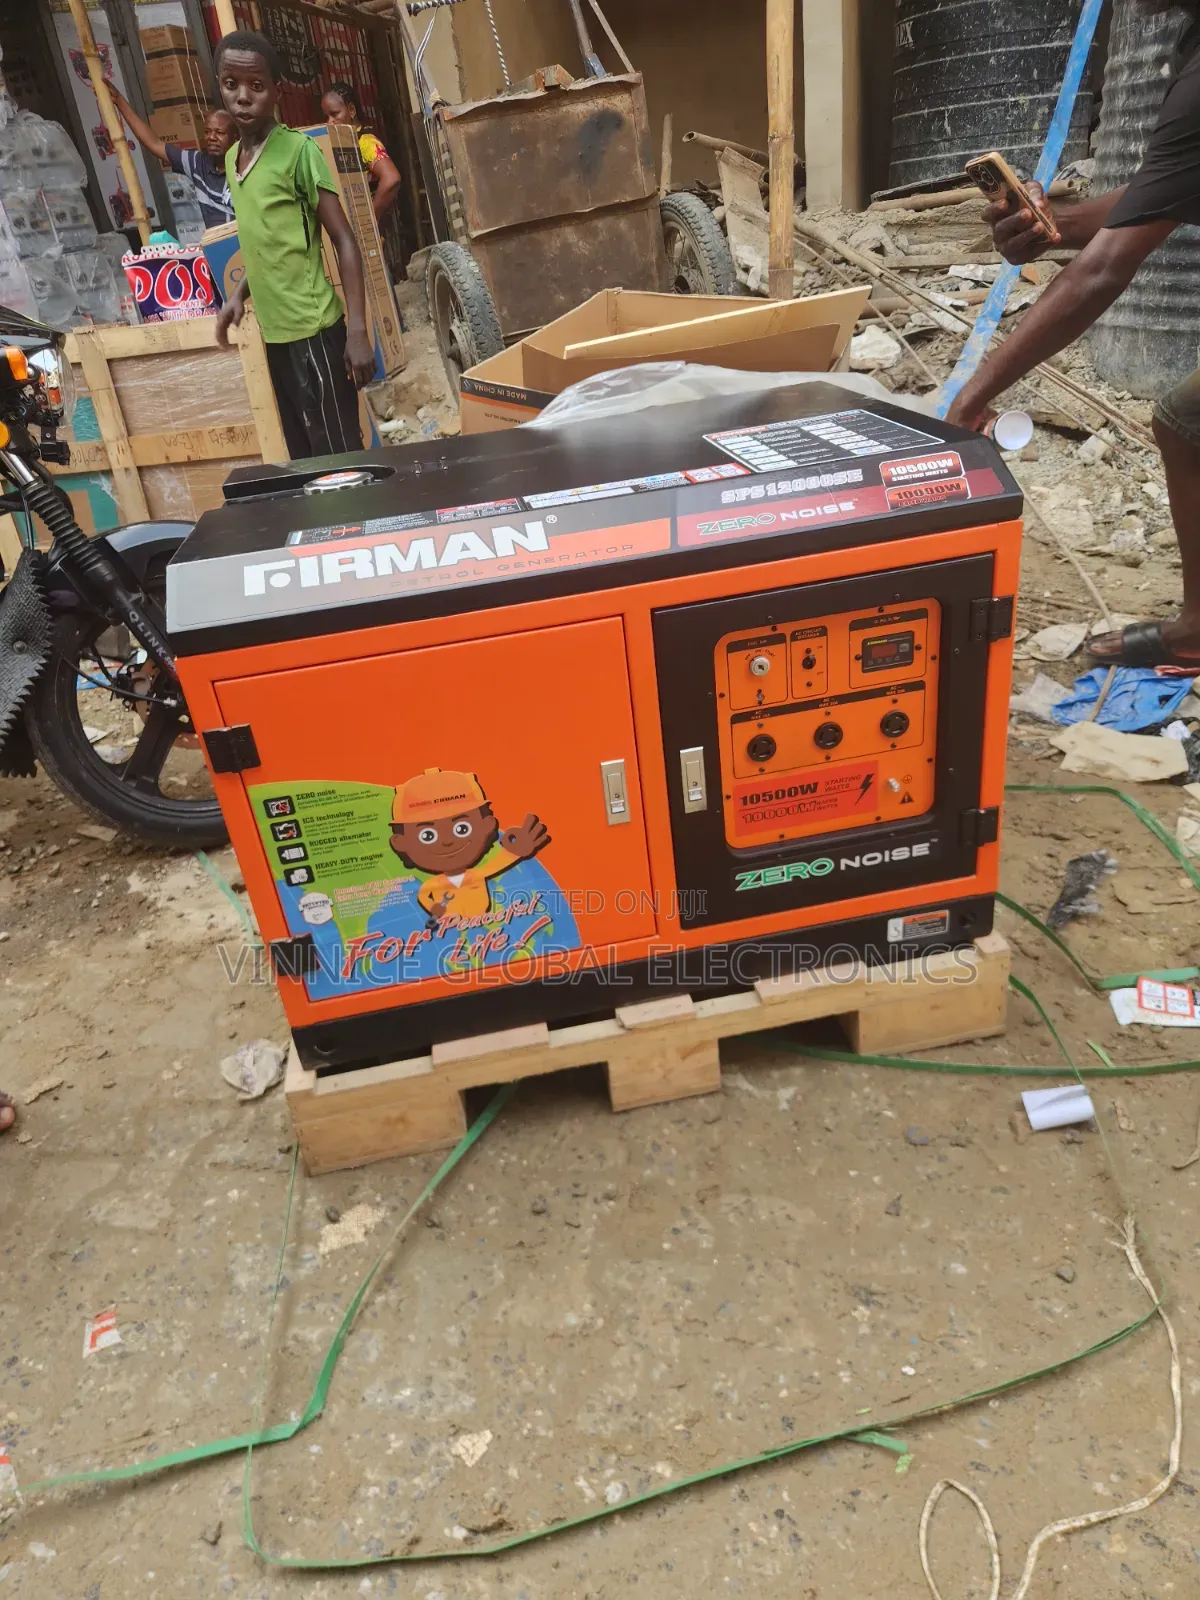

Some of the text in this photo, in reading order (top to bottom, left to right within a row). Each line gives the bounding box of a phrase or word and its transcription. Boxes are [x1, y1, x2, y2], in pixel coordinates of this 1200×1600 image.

[124, 256, 214, 308] POS
[474, 384, 496, 394] CHINA
[507, 390, 527, 400] MADE
[888, 458, 954, 475] 10500W
[892, 468, 948, 481] STARTING WATTS
[697, 500, 856, 536] ZERO NOISE
[243, 521, 549, 597] FIRMAN
[390, 545, 634, 588] PETROL GENERATOR
[129, 610, 166, 657] QLINK
[824, 774, 862, 787] STARTING
[296, 788, 336, 801] ZERO noise
[740, 781, 850, 807] 10500W WATTS
[303, 810, 354, 825] ICS technology
[742, 800, 838, 824] 10000W WATTS
[309, 837, 337, 847] RUGGED
[339, 831, 372, 842] alternator
[360, 852, 384, 863] engine
[735, 843, 930, 891] ZERO NOISE
[341, 927, 432, 980] For
[436, 893, 542, 938] Peaceful
[450, 915, 552, 964] Life!
